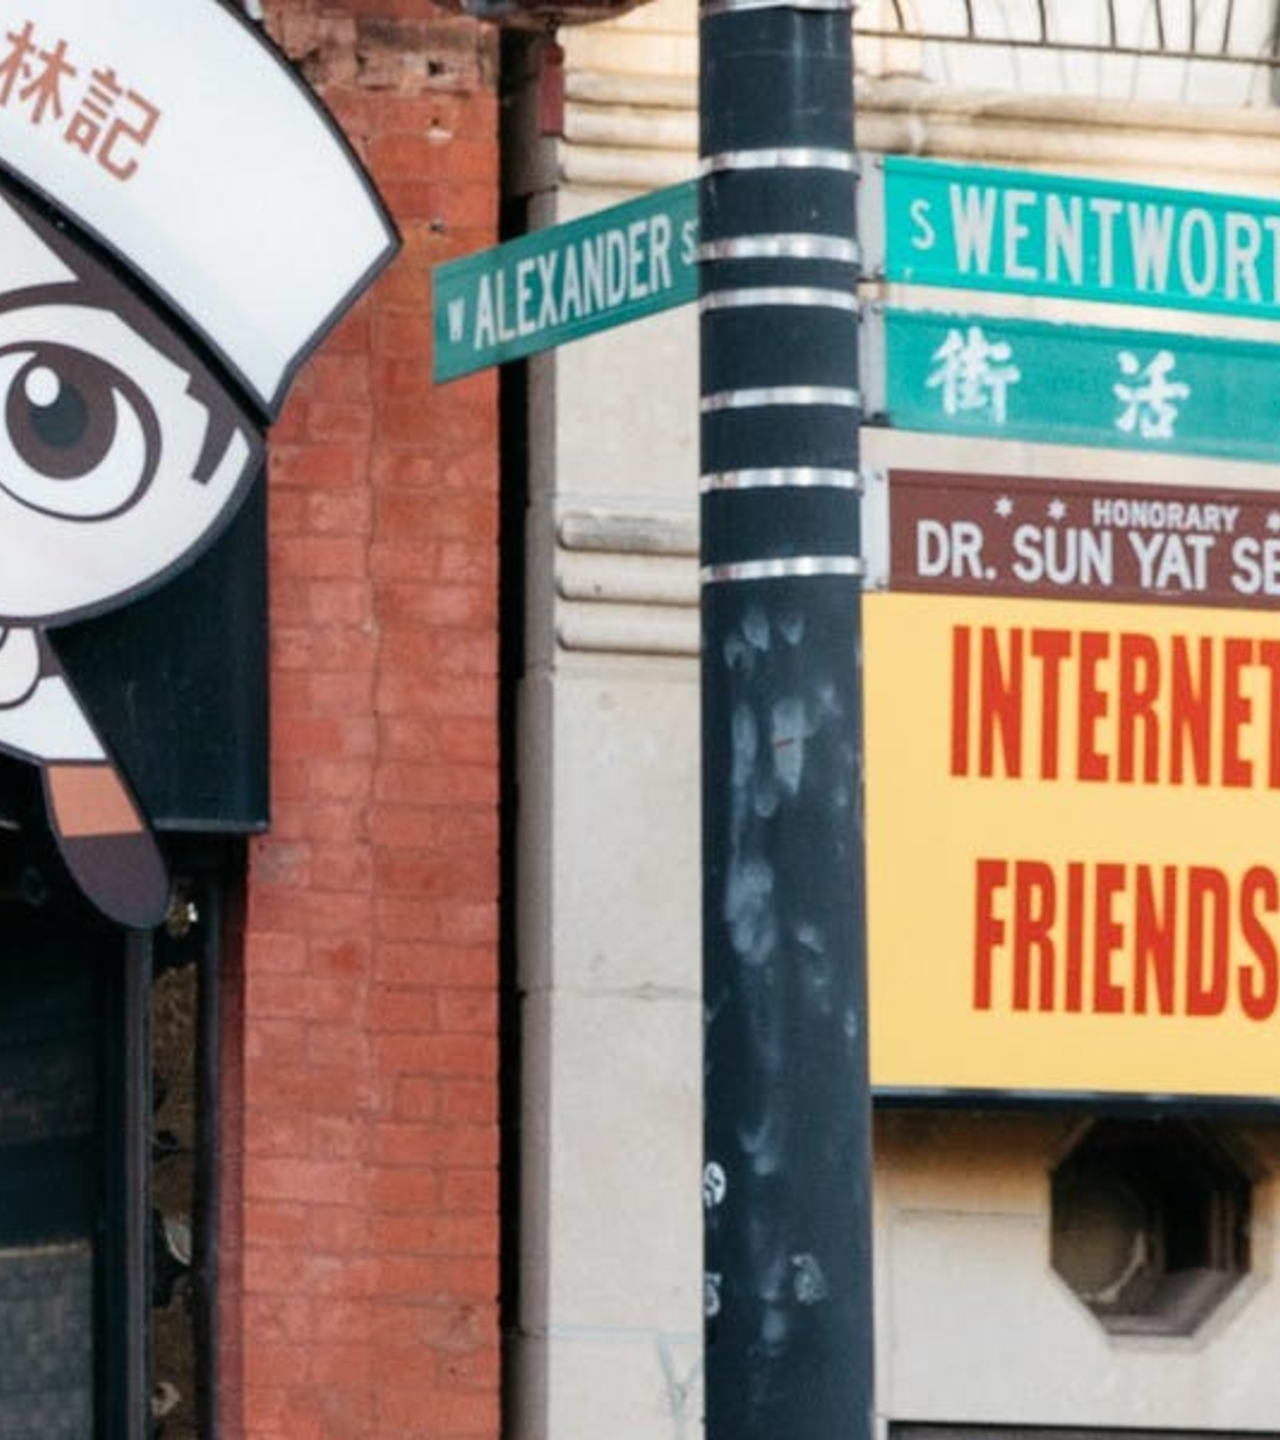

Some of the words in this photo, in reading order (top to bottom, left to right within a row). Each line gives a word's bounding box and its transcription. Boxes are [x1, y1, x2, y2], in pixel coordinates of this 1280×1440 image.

[909, 199, 935, 251] S
[447, 296, 466, 343] W
[473, 213, 671, 350] ALEXANDER
[680, 218, 699, 267] S
[1093, 498, 1240, 534] HONORARY
[917, 519, 997, 582] DR.
[1012, 526, 1113, 588] SUN
[1130, 533, 1216, 592] YAT
